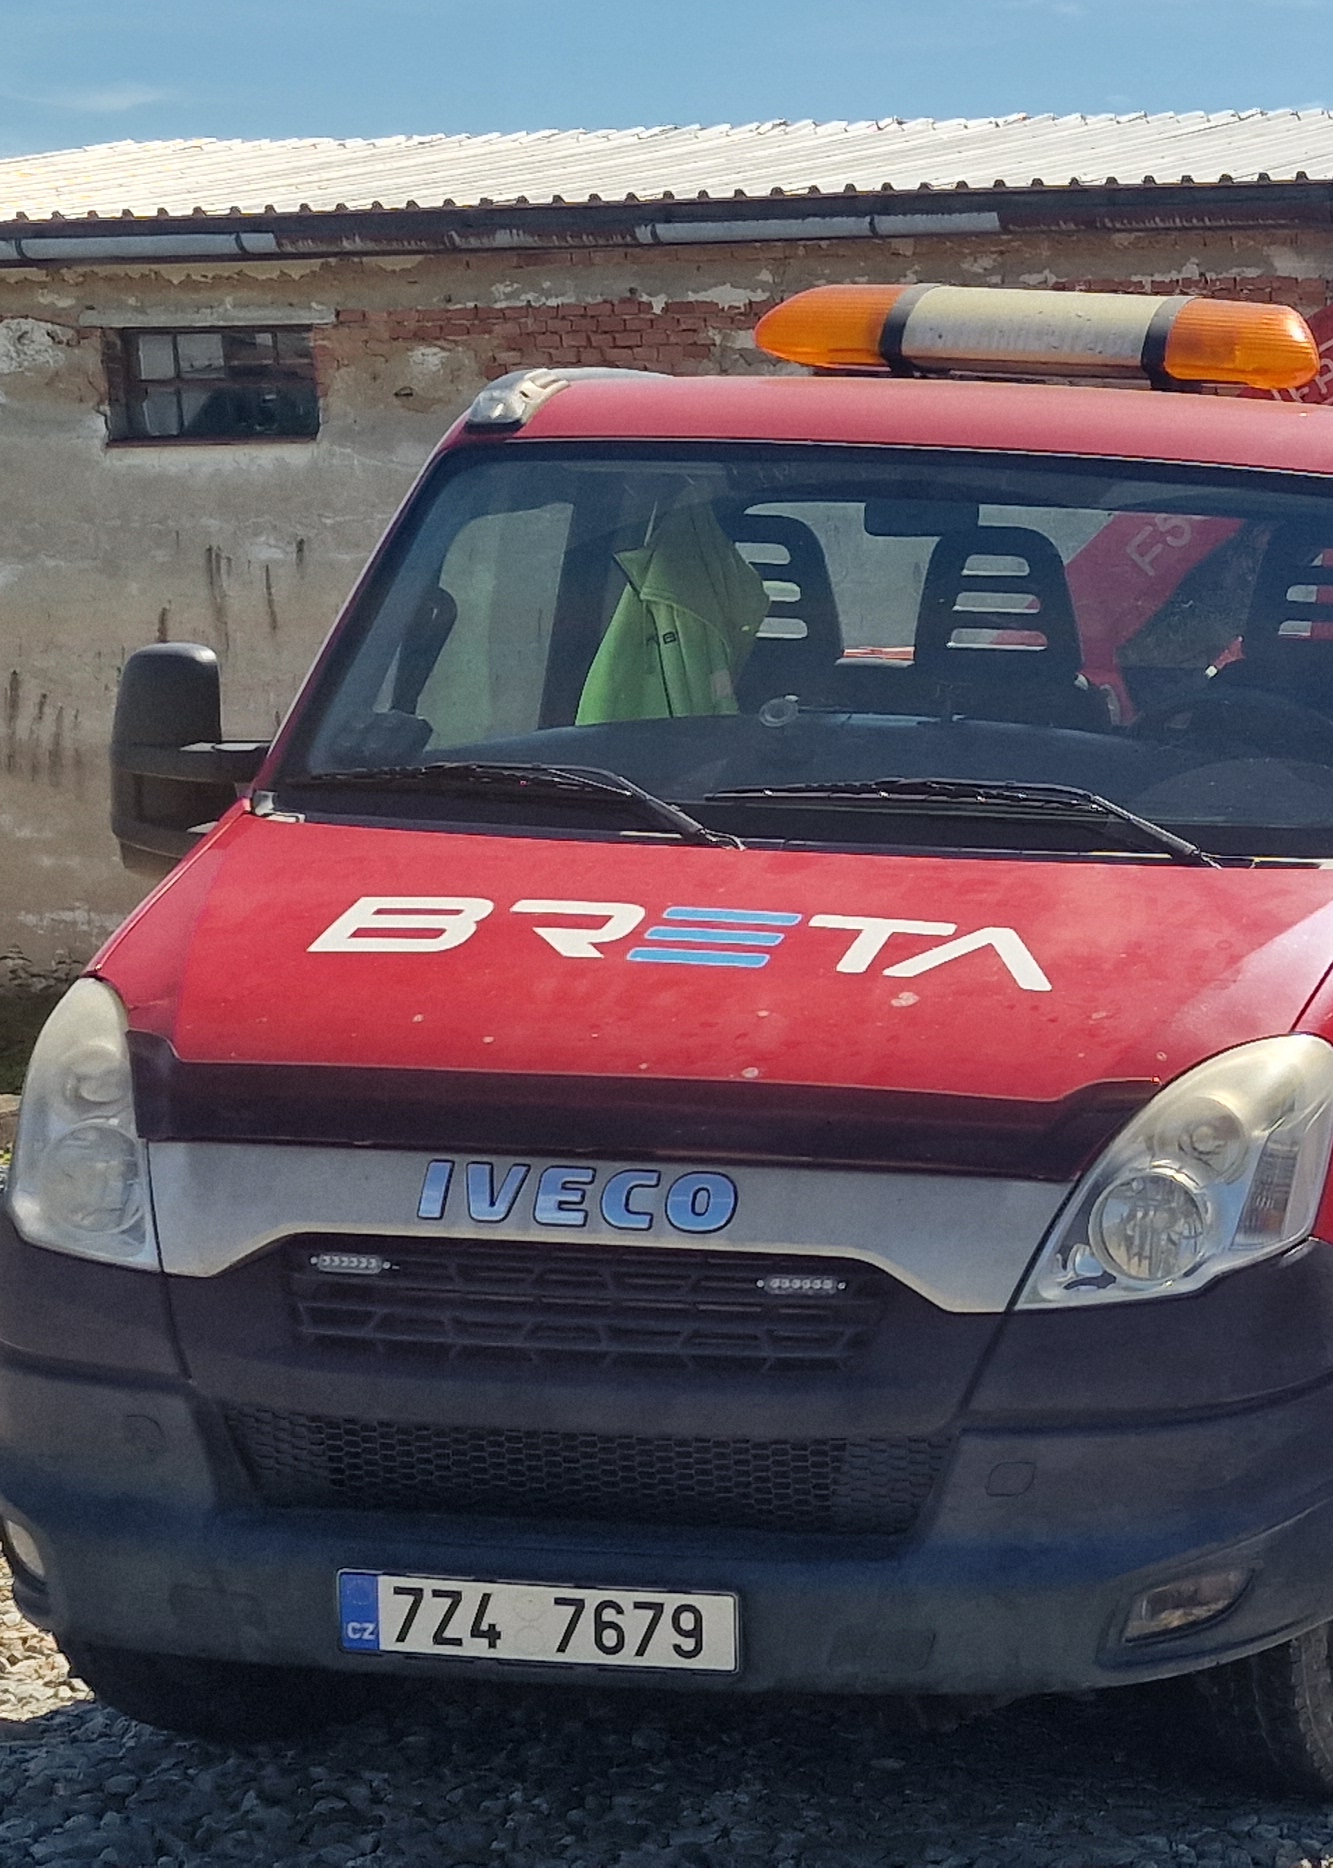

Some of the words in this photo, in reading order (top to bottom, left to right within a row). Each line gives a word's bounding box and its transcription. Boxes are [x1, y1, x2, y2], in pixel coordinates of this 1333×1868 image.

[306, 896, 1053, 992] BRETA
[417, 1159, 738, 1234] IVECO
[346, 1622, 376, 1641] CZ
[393, 1586, 501, 1650] 7Z4
[553, 1597, 703, 1659] 7679
